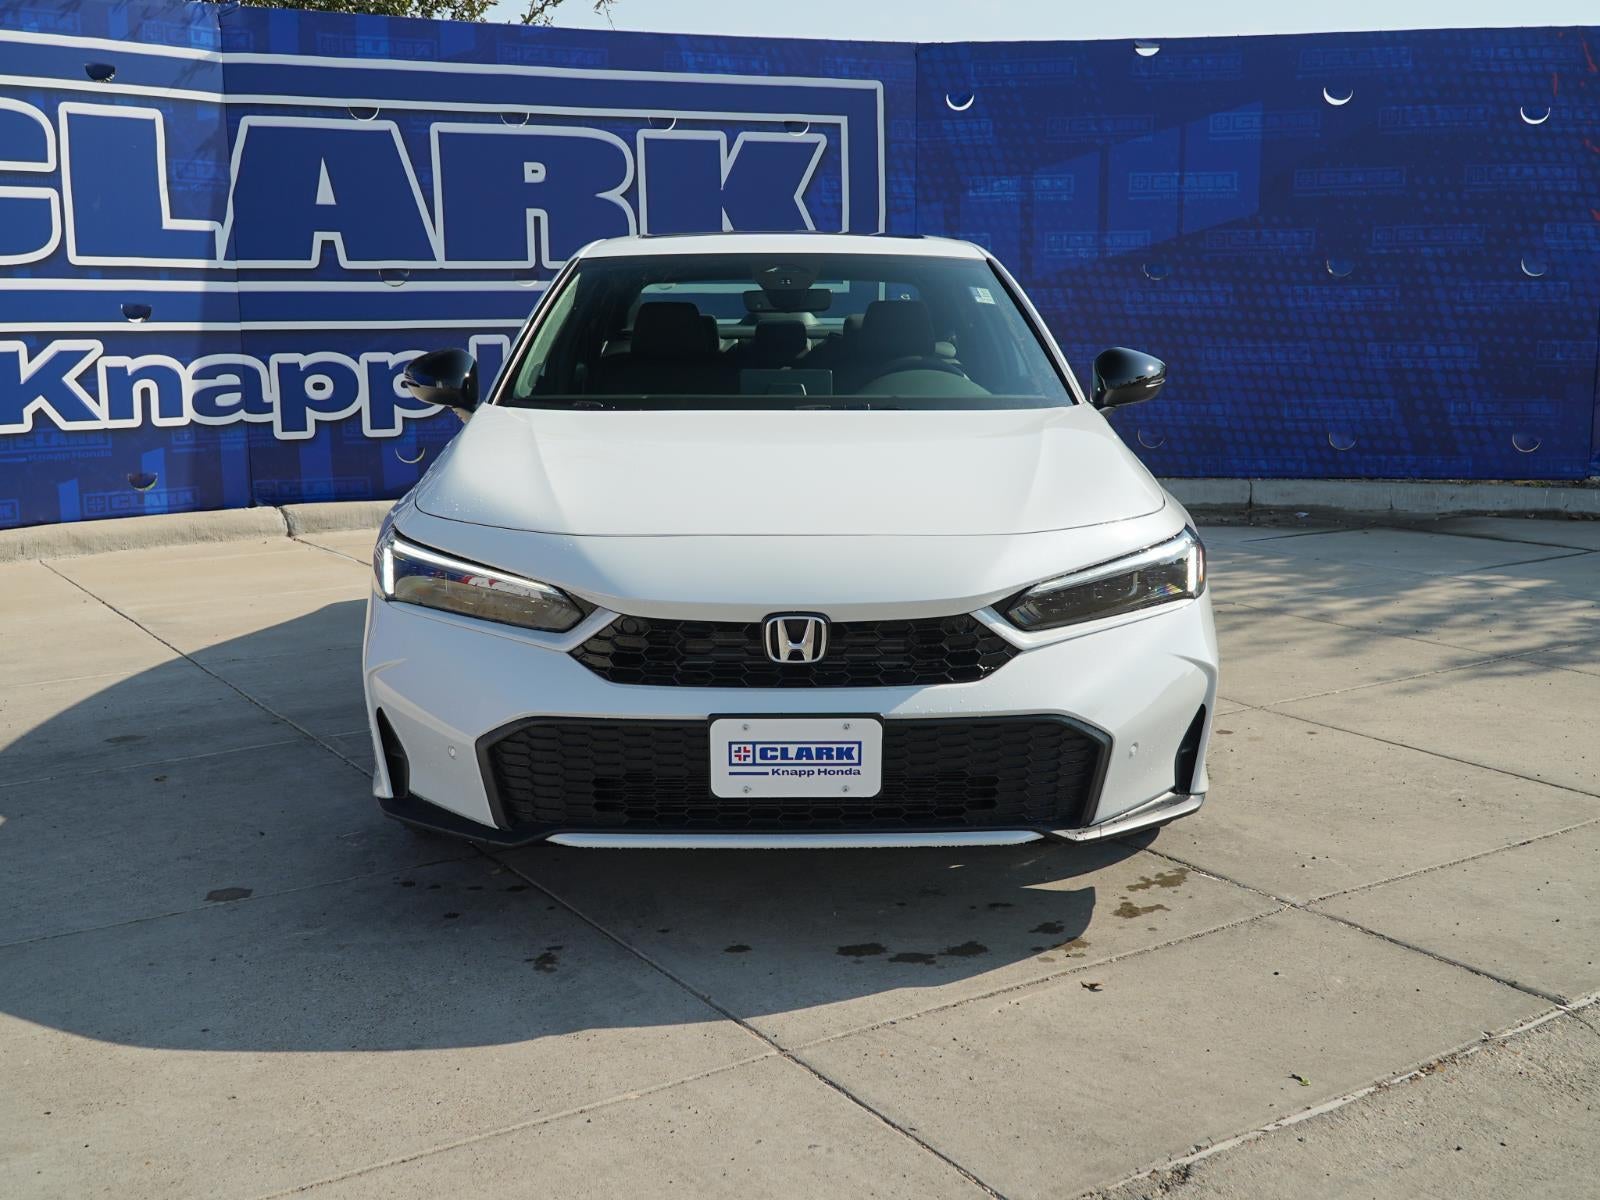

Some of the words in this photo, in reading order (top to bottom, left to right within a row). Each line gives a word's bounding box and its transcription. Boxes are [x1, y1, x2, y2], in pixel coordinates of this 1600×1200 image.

[759, 746, 855, 761] CLARK
[771, 768, 815, 778] Knapp
[817, 768, 861, 776] Honda
